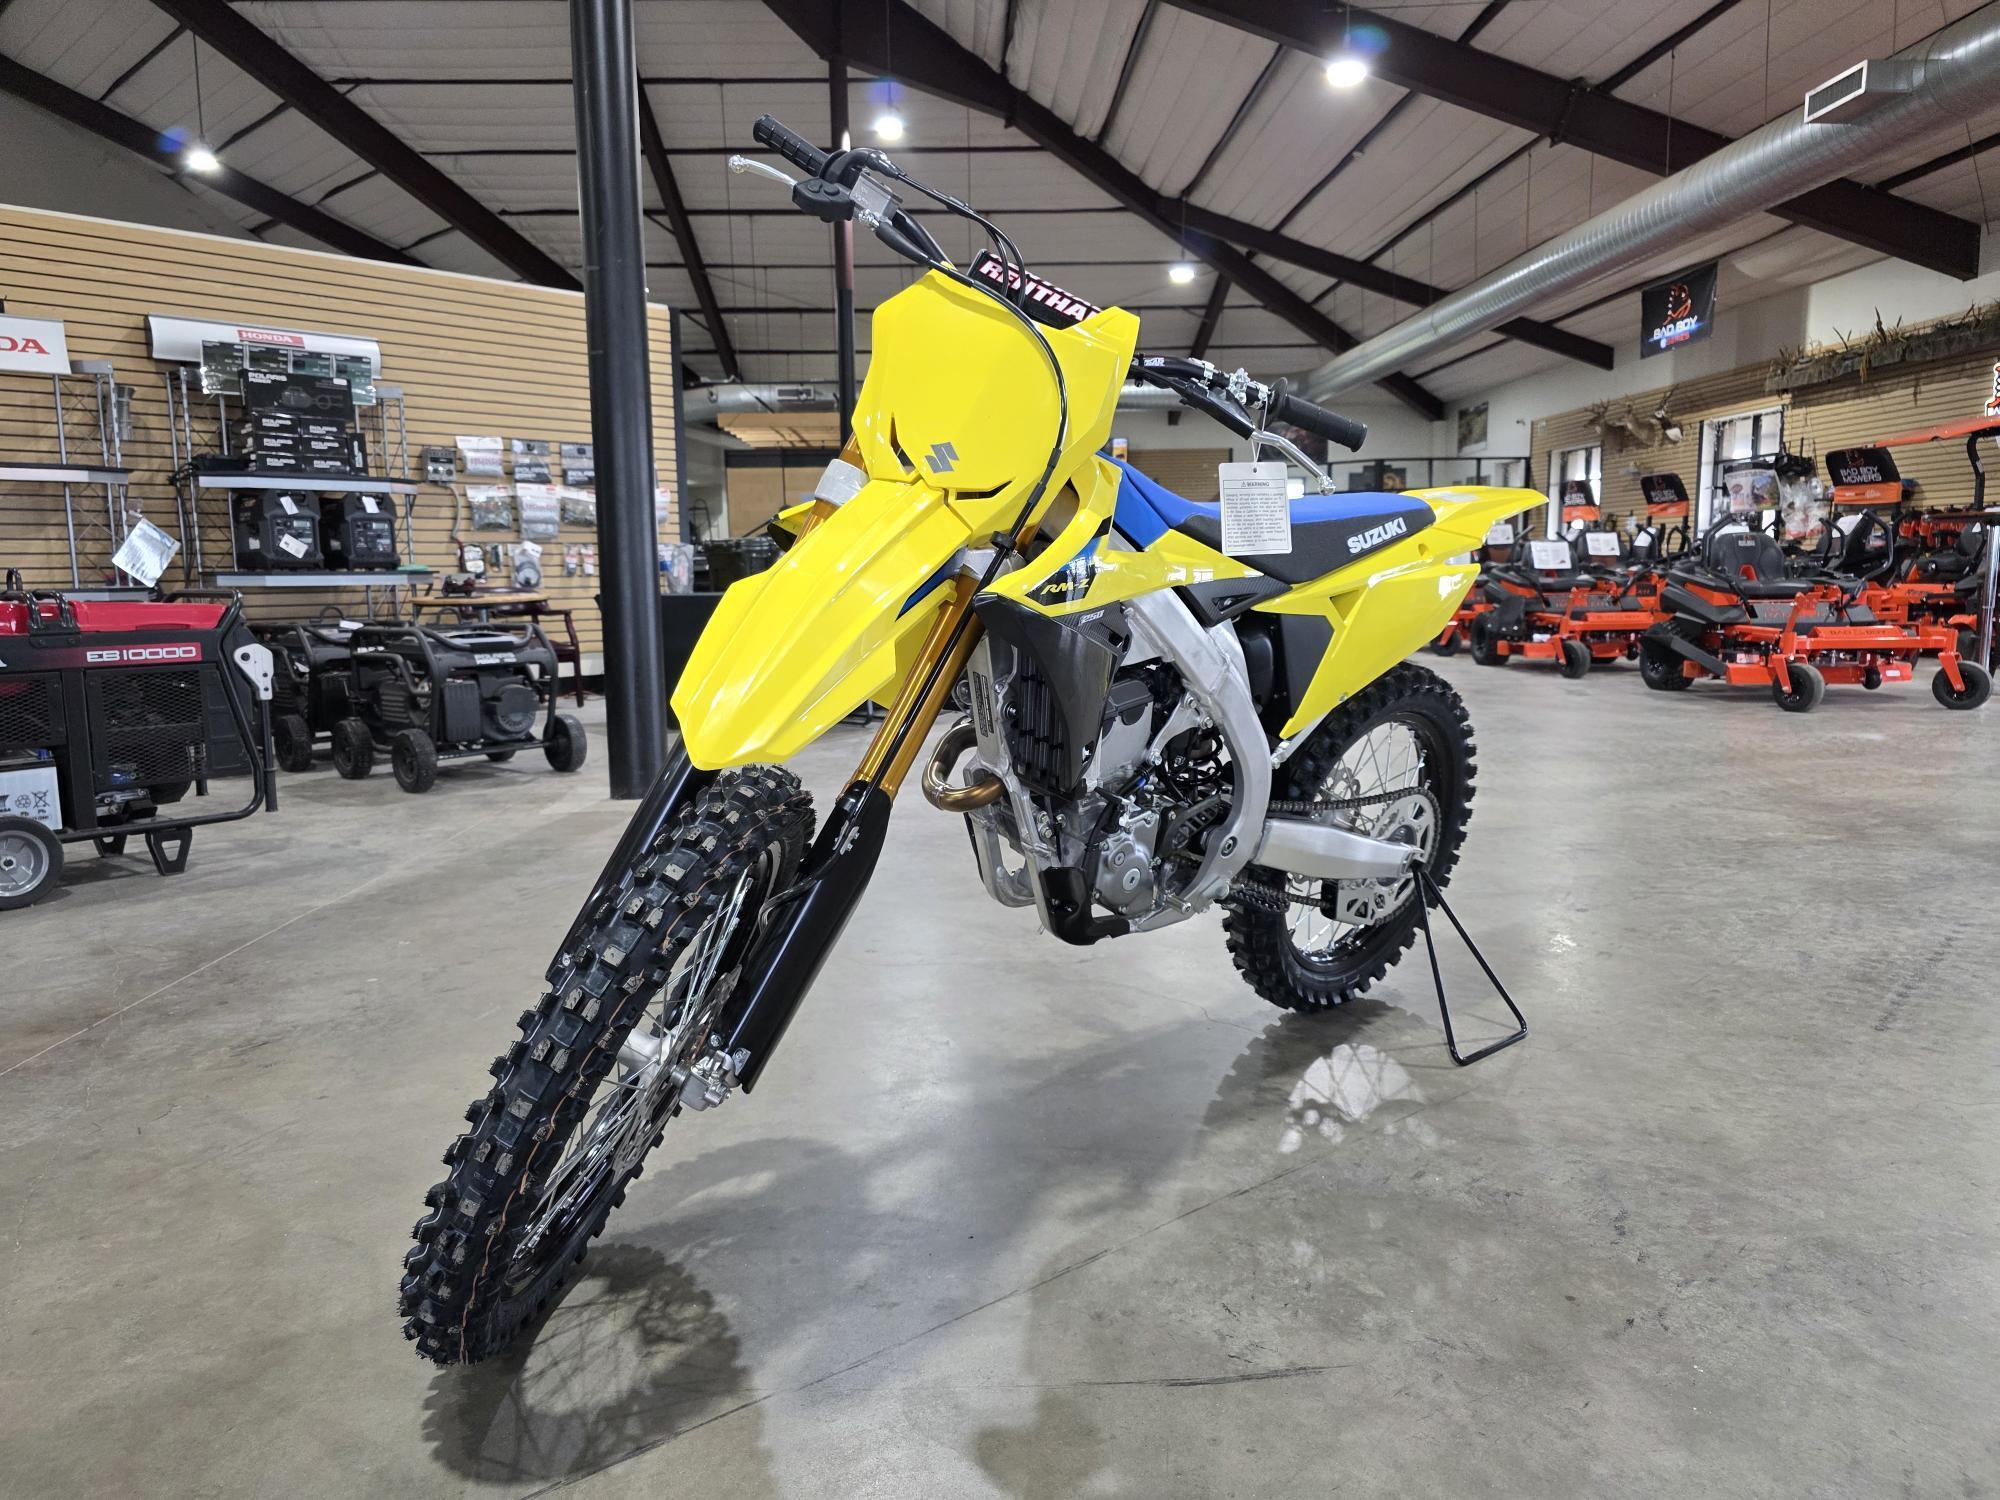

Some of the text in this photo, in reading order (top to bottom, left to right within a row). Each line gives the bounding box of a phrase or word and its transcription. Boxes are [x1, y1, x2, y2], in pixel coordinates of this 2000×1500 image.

[1653, 323, 1675, 340] BAD
[1676, 315, 1698, 332] BOY
[240, 330, 294, 343] HONDA
[248, 372, 288, 382] POLARIS
[1840, 465, 1878, 476] BAD BOY
[1347, 516, 1407, 554] SUZUKI
[1040, 578, 1090, 595] RM-Z
[1080, 609, 1105, 624] 250
